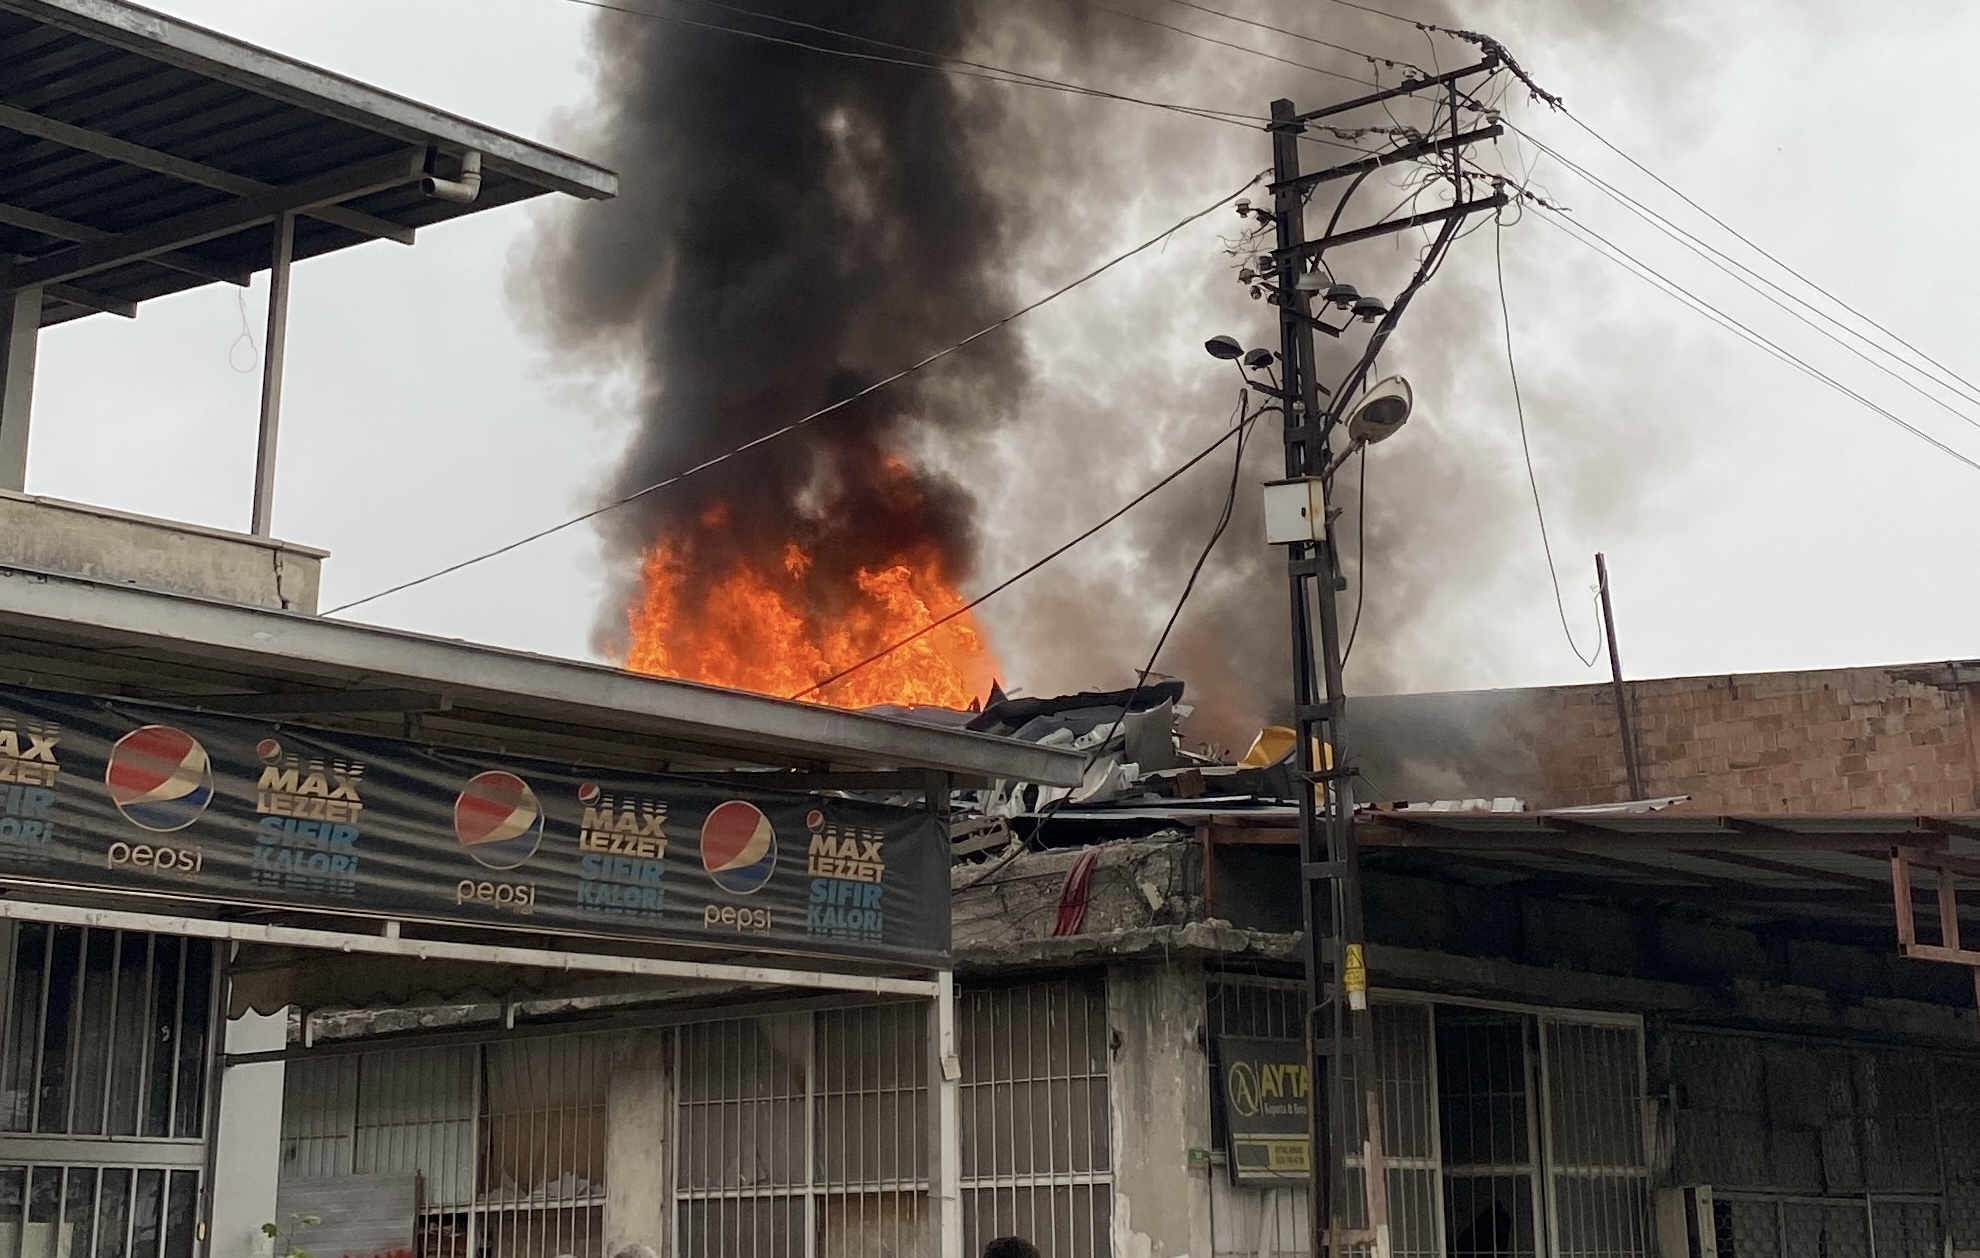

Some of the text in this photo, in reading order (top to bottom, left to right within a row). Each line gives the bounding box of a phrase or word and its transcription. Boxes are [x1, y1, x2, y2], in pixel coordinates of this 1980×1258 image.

[0, 724, 62, 763] AX
[0, 757, 60, 787] ZET
[256, 757, 365, 801] MAX
[256, 791, 364, 824] LEZZET
[581, 798, 669, 838] MAX
[256, 816, 360, 852] SIFIR
[579, 830, 669, 859] LEZZET
[808, 829, 885, 862] MAX
[107, 841, 203, 874] pepsi
[580, 853, 666, 882] SIFIR
[808, 856, 885, 883] LEZZET
[456, 879, 536, 909] pepsi
[809, 879, 883, 909] SIFIR
[704, 905, 771, 932] pepsi
